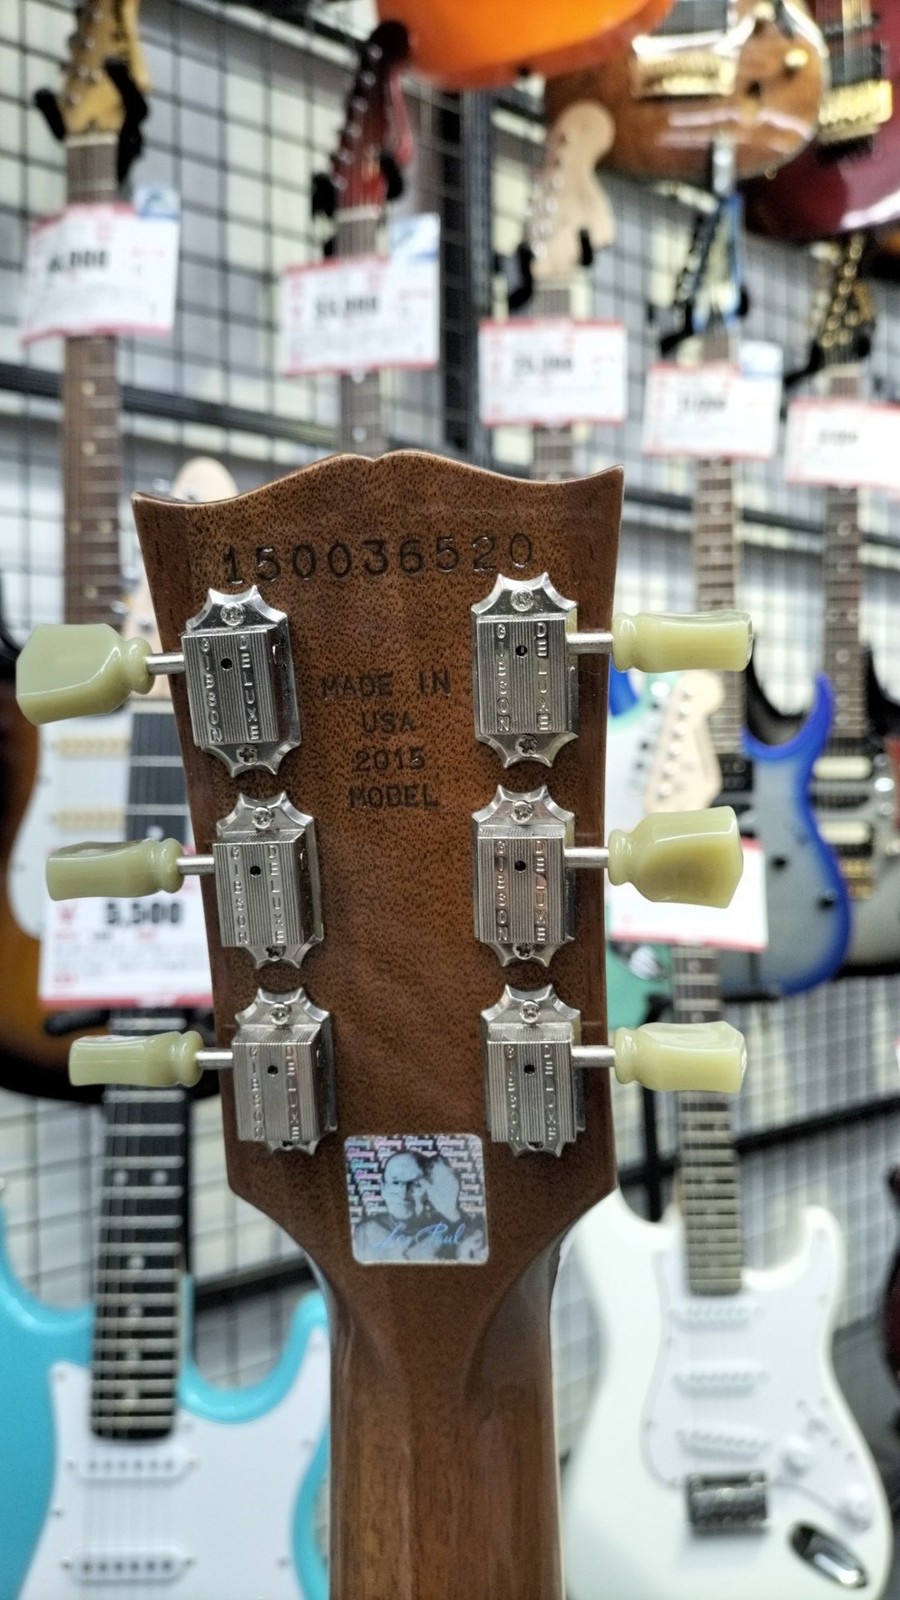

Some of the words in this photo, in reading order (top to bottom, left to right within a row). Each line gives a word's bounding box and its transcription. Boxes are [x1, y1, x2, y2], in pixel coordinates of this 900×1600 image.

[222, 532, 533, 585] 150036520
[201, 637, 223, 743] GIBSON
[239, 634, 260, 741] DELUXE
[320, 671, 394, 698] MADE
[418, 670, 451, 697] IN
[536, 622, 549, 731] DELUXE
[362, 710, 417, 734] USA
[352, 747, 426, 772] 2015
[348, 783, 439, 808] MODEL
[268, 844, 285, 944] DELUXE
